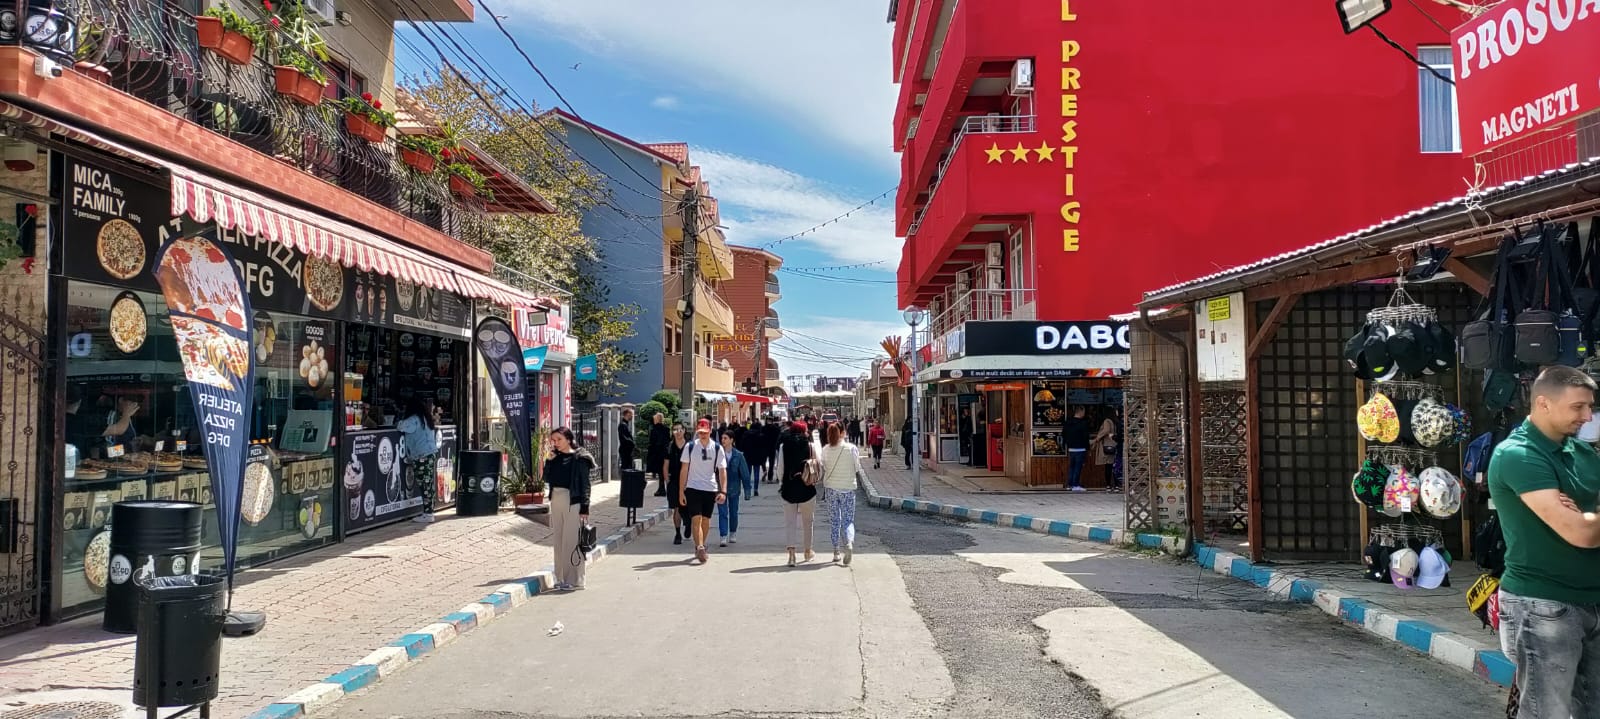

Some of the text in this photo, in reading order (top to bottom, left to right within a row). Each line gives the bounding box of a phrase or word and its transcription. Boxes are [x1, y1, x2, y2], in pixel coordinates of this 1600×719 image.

[1482, 84, 1580, 145] MAGNETI
[1061, 40, 1081, 252] PRESTIGE
[74, 163, 112, 193] MICA
[73, 186, 126, 217] FAMILY
